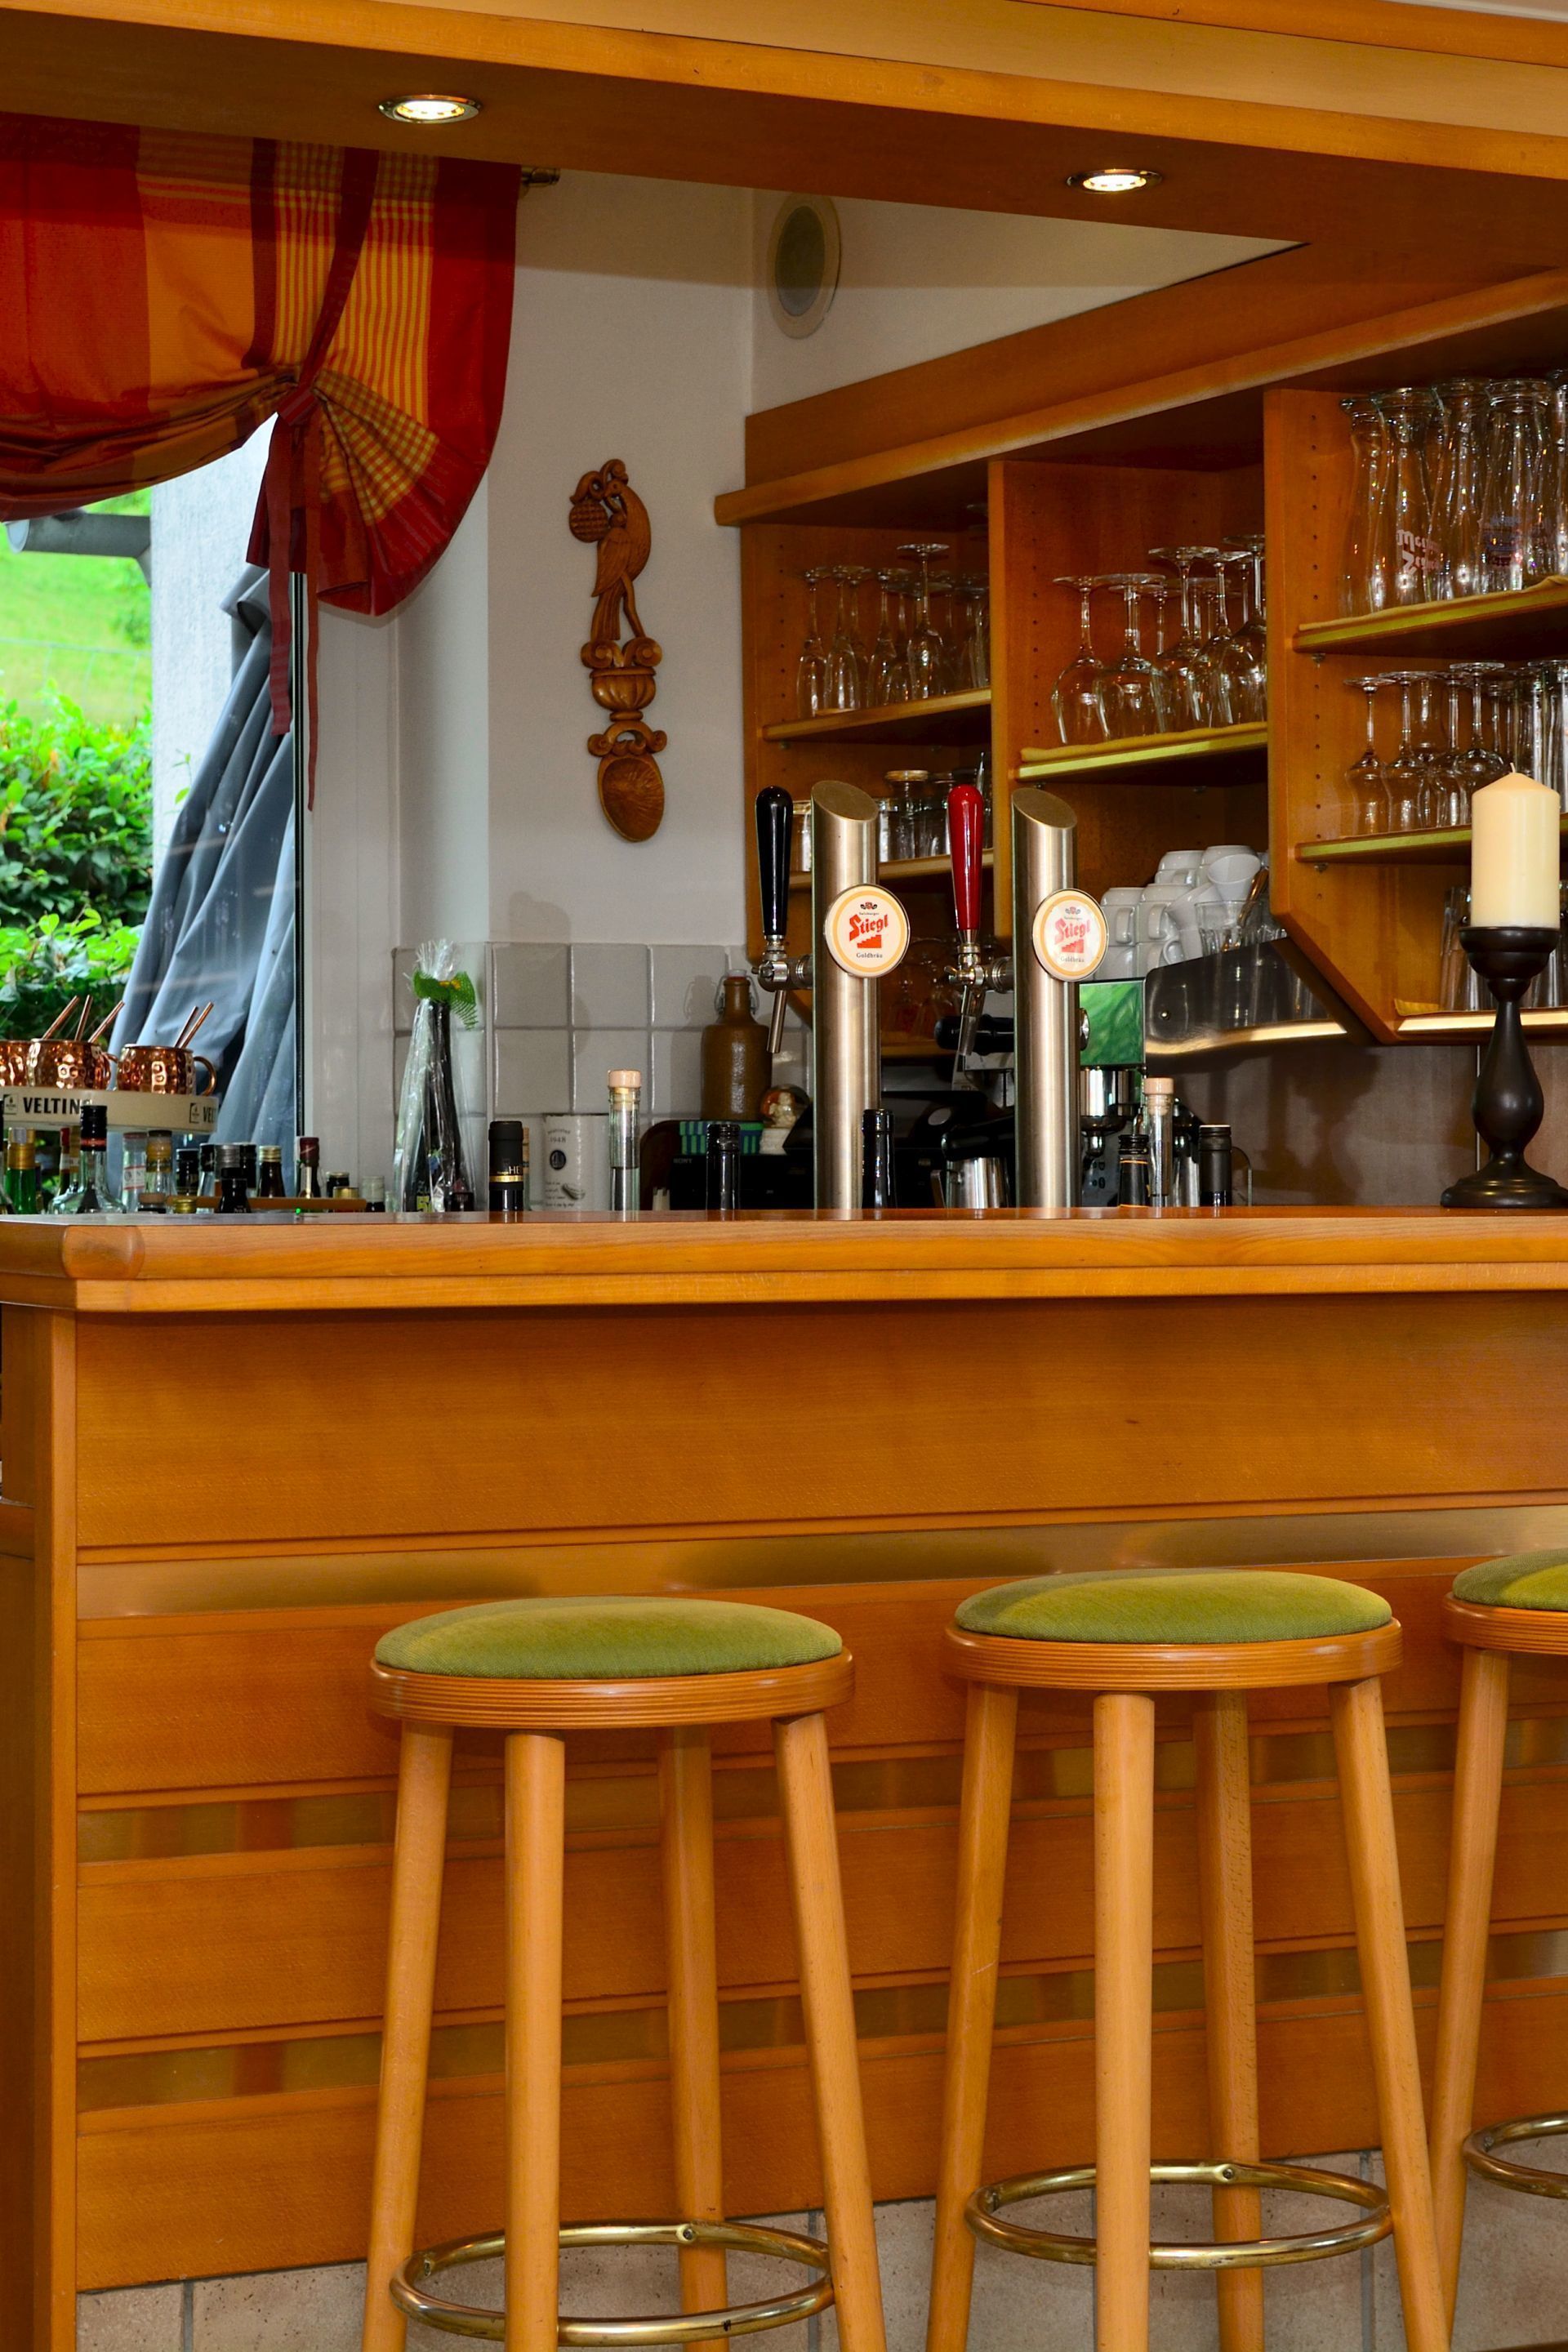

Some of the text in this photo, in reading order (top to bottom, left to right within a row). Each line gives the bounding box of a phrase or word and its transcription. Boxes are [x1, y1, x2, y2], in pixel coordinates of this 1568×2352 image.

[849, 913, 889, 942] Stiegl
[1054, 917, 1091, 945] Stiegl
[23, 1097, 91, 1115] VELTIN
